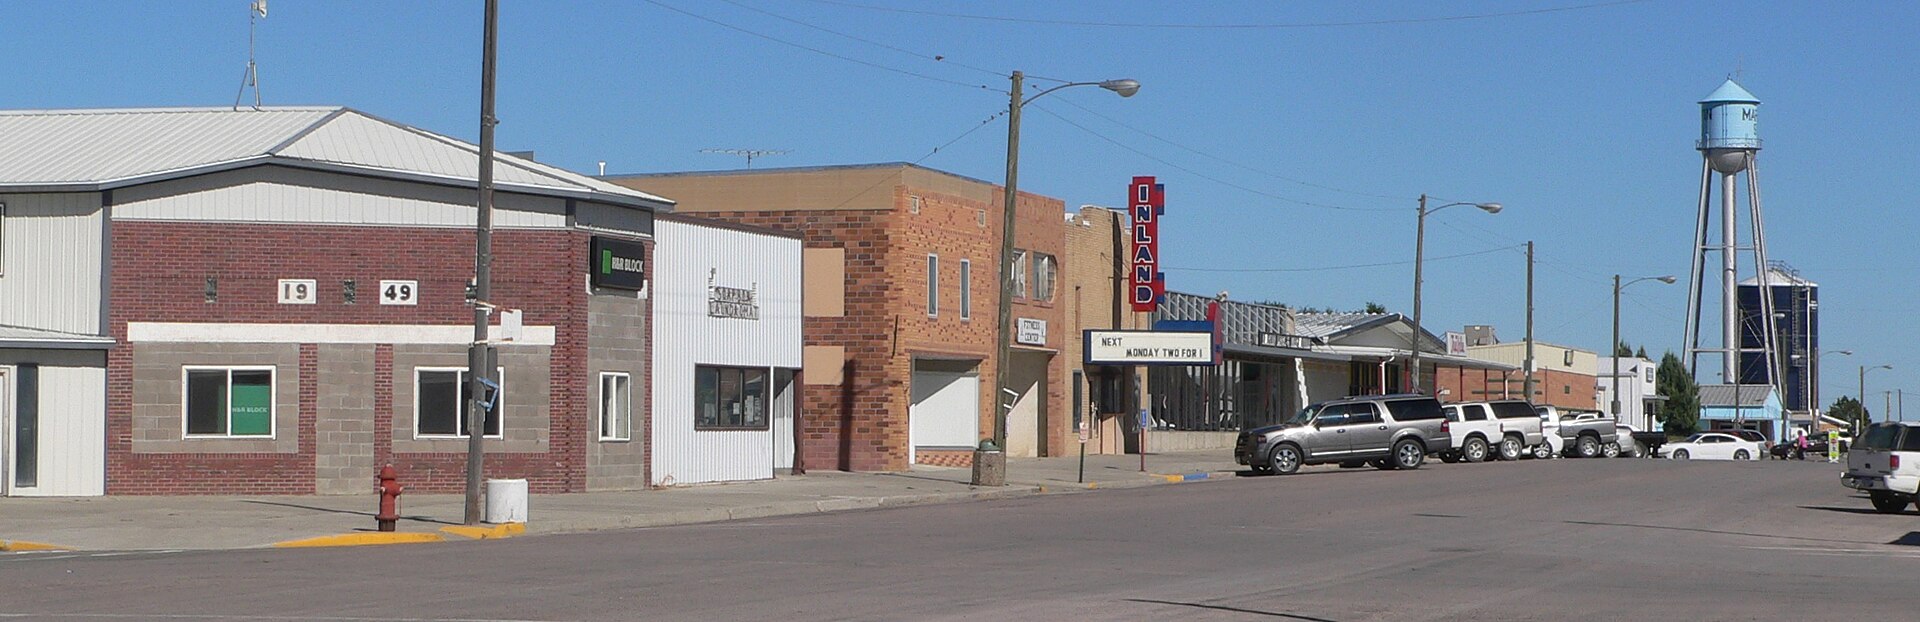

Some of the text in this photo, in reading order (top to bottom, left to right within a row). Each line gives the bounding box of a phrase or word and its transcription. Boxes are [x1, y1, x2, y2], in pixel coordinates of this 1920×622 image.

[1134, 184, 1154, 304] INLAND
[612, 256, 644, 273] H&R BLOCK
[284, 283, 307, 300] 19
[384, 284, 411, 301] 49
[1101, 337, 1122, 347] NEXT
[1126, 348, 1159, 358] MONDAY
[1163, 348, 1180, 358] TWO
[1181, 348, 1197, 358] FOR
